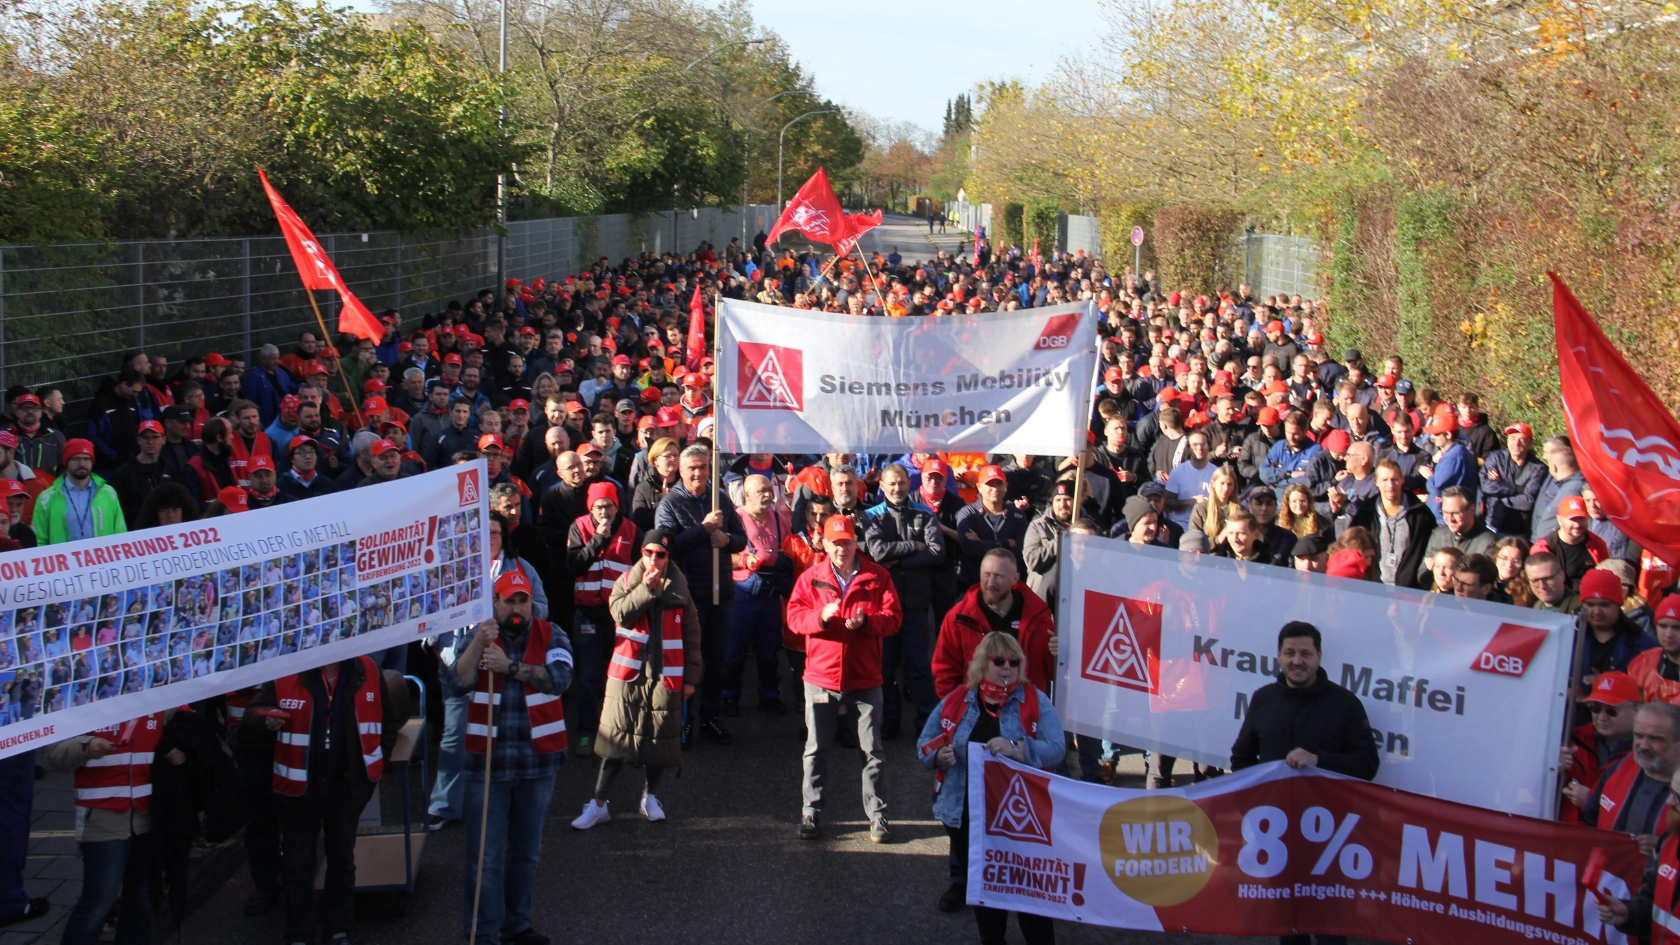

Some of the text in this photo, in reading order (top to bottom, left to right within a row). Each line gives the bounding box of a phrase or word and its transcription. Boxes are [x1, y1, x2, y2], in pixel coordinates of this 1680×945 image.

[1039, 336, 1068, 348] DGB
[820, 368, 1071, 396] Siemens Mobility
[880, 406, 1011, 429] München
[358, 520, 426, 552] SOLIDARITÄT
[13, 575, 84, 603] GESICHT
[91, 567, 122, 592] FÜR
[126, 562, 151, 583] DIE
[155, 542, 258, 578] FORDERUNGEN
[258, 535, 287, 554] DER
[287, 531, 302, 548] IG
[304, 521, 351, 544] METALL
[31, 553, 70, 577] ZUR
[71, 535, 179, 569] TARIFRUNDE
[178, 527, 222, 549] 2022
[358, 558, 422, 583] TARIFBEWEGUNG 2022
[1193, 635, 1466, 716] Krau Maffei
[1480, 652, 1523, 674] DGB
[279, 699, 306, 710] GEBT
[366, 692, 375, 702] 8!
[147, 719, 157, 730] 8!
[1120, 821, 1194, 854] WIR
[984, 848, 1070, 876] SOLIDARITÄT
[1114, 854, 1208, 878] FORDERN
[983, 883, 1067, 904] TARIFBEWEGUNG 2022
[1397, 823, 1632, 945] MEHR
[1238, 884, 1290, 899] Höhere
[1294, 883, 1355, 900] Entgelte
[1391, 891, 1445, 914] Höhere
